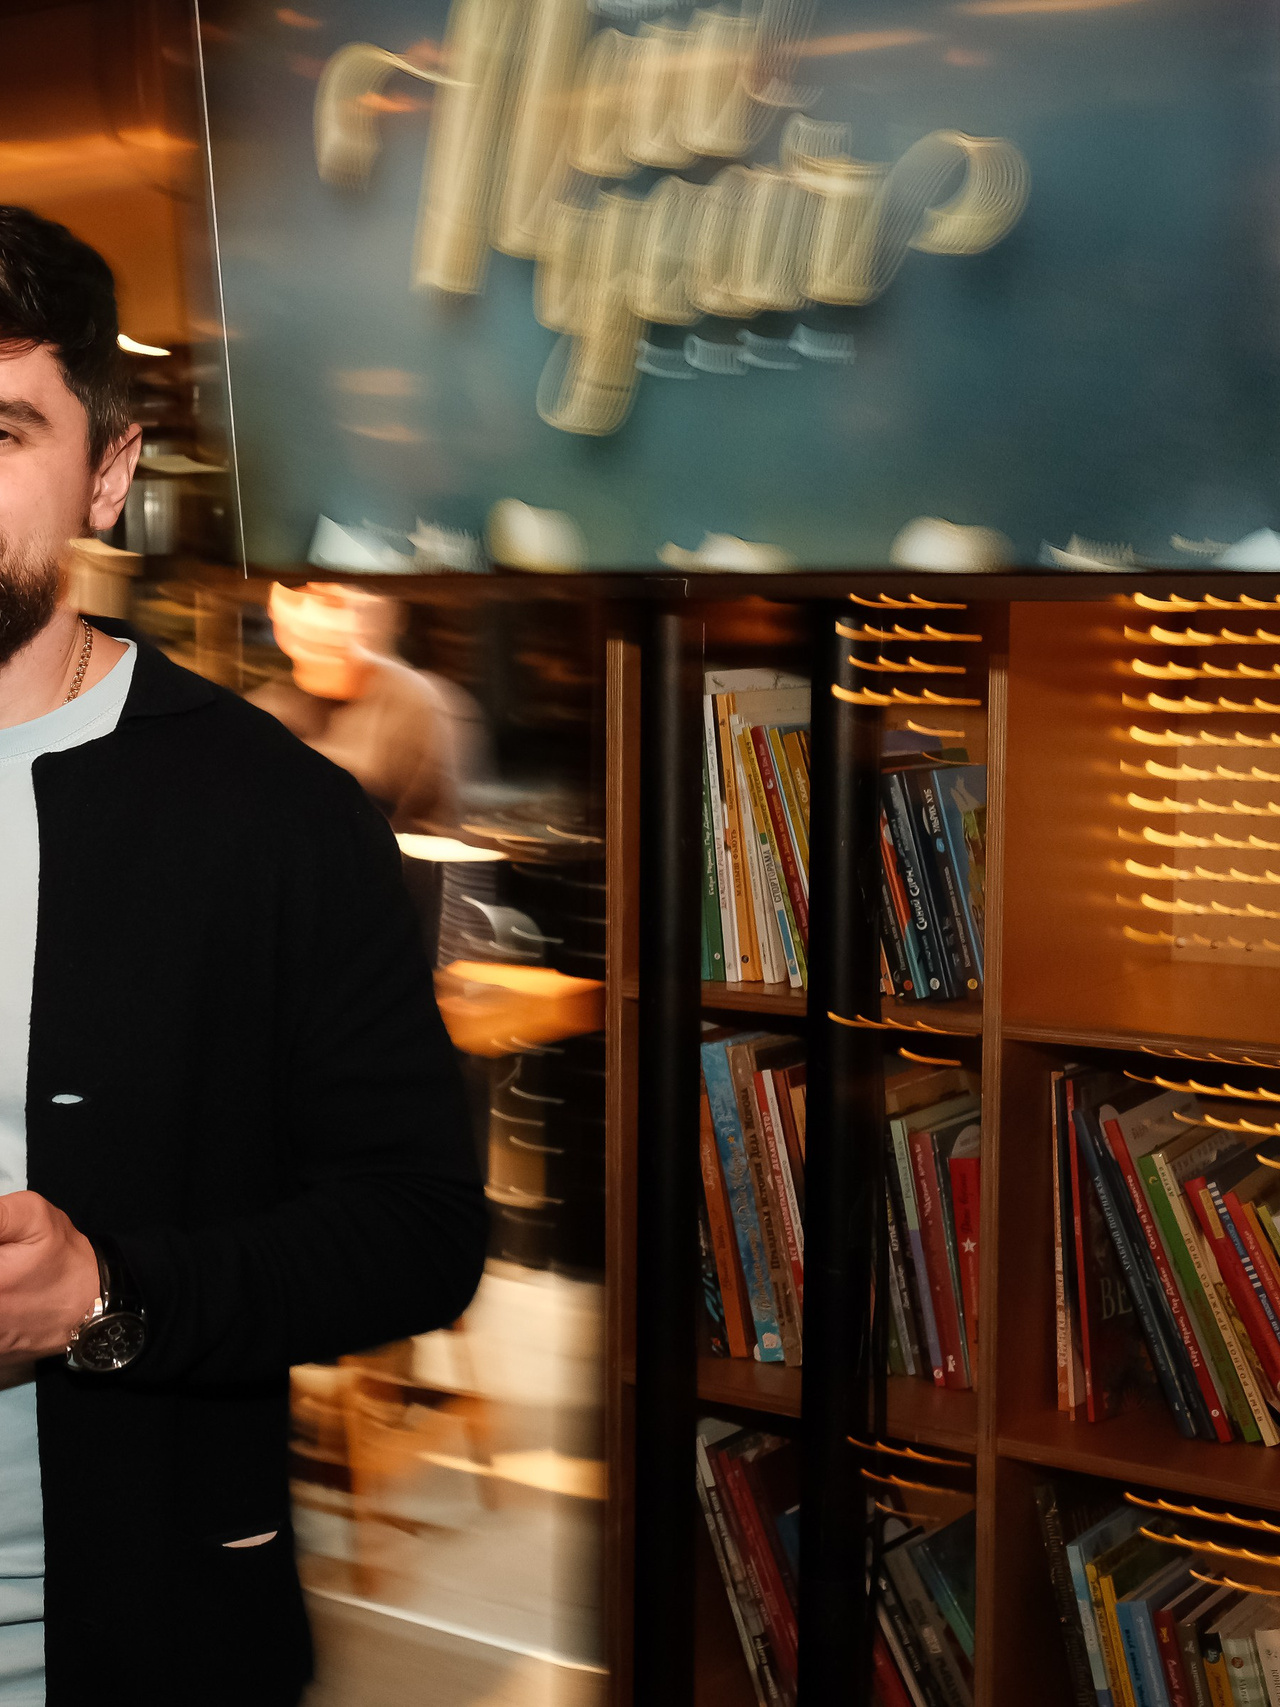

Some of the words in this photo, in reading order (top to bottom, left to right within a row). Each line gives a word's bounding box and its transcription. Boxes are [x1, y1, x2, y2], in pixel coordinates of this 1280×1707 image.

[1200, 1272, 1210, 1288] СО
[1207, 1293, 1227, 1331] ДРУЖИ
[1247, 1391, 1263, 1421] ЯЗЫК
